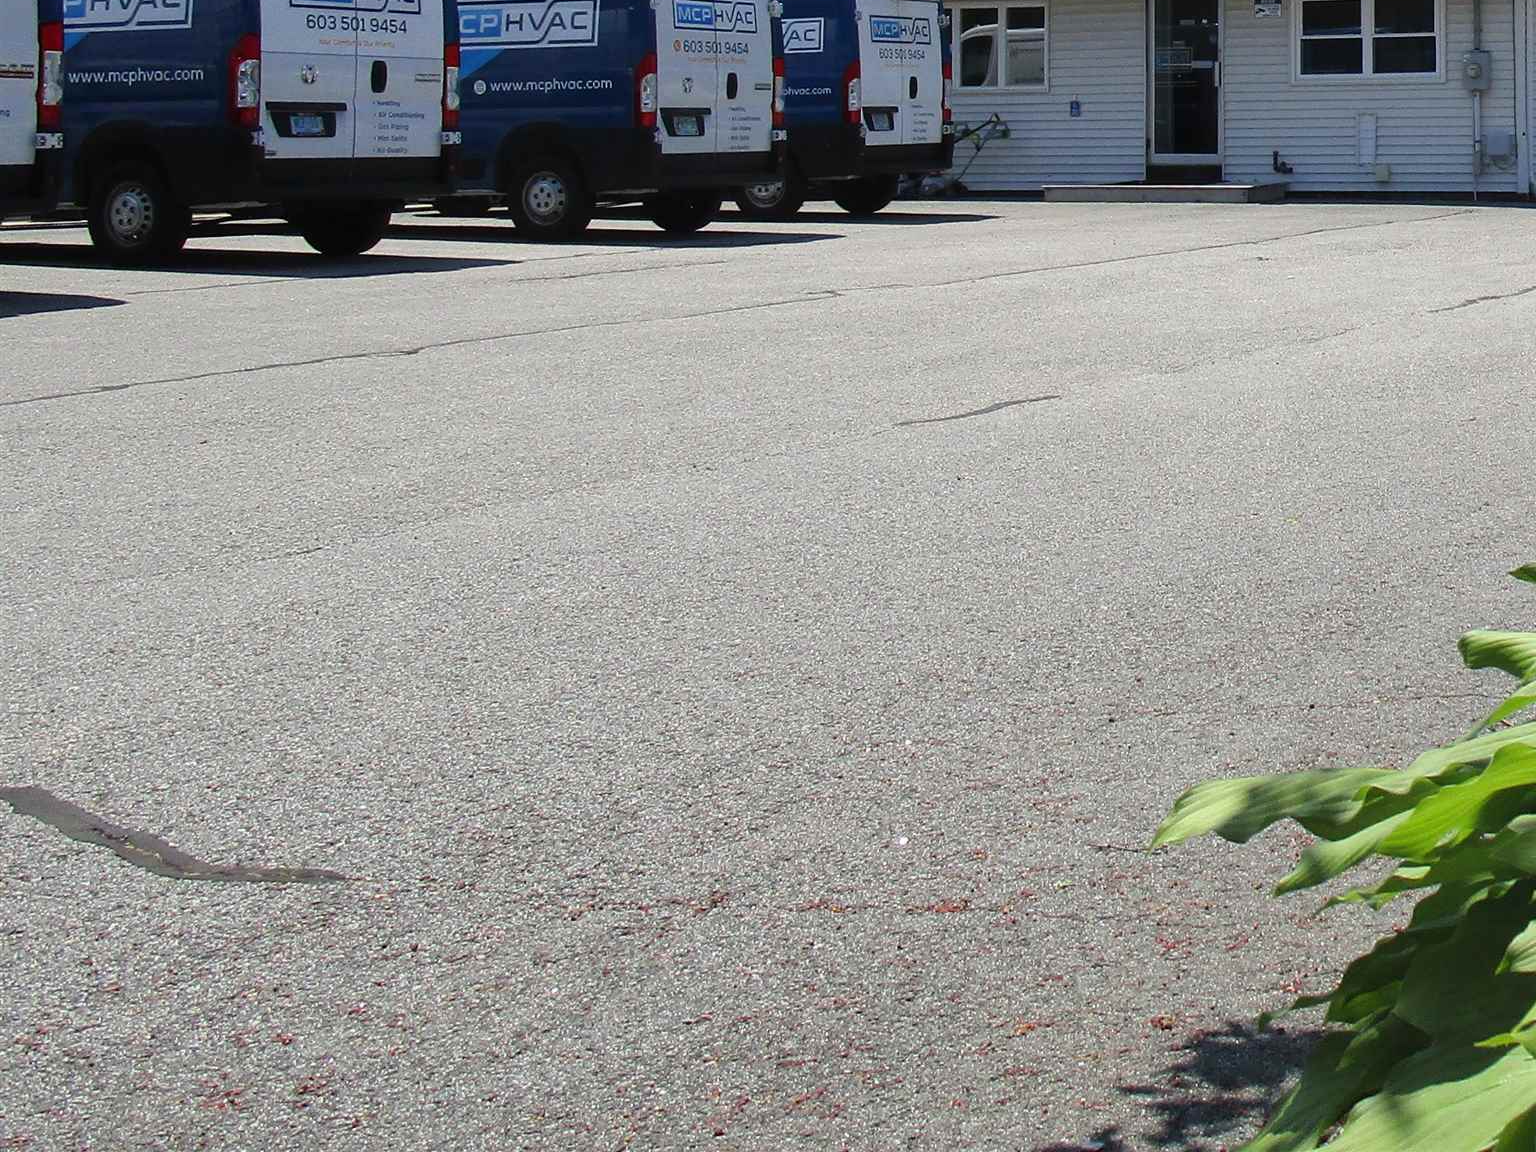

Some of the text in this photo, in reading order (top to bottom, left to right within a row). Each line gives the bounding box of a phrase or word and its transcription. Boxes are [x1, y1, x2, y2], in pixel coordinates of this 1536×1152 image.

[306, 14, 407, 34] 603 501 9454
[459, 10, 588, 34] CP HVAC
[678, 6, 753, 24] MCP HVAC
[683, 40, 749, 54] 603 501 9454
[68, 67, 204, 85] www.mcphvac.com
[490, 78, 613, 93] www.mcphvac.com
